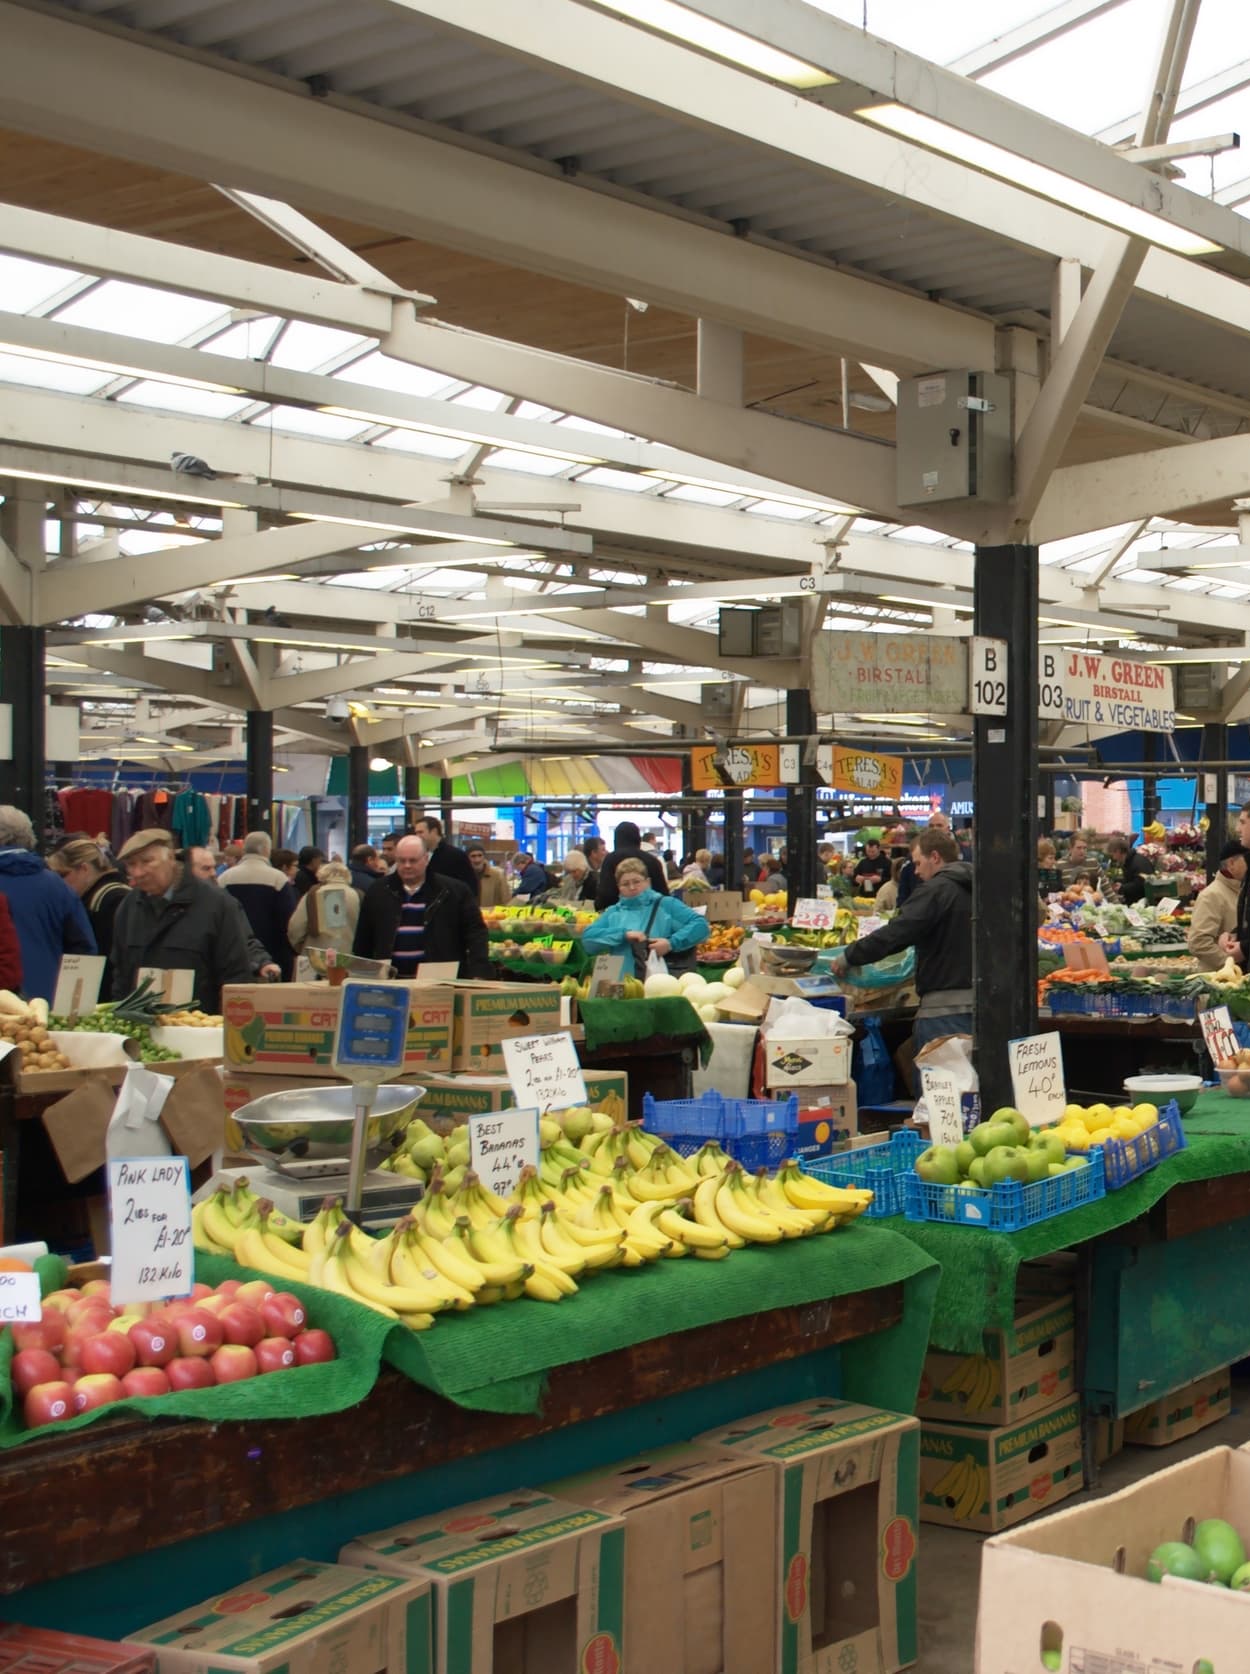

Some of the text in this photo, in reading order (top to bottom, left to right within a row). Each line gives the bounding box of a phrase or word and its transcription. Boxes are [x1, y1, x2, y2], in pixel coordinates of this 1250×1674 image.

[800, 577, 815, 590] C3
[418, 605, 435, 617] C12
[885, 642, 957, 664] GREEN
[985, 648, 997, 672] B
[857, 667, 932, 685] BIRSTALL
[1044, 655, 1055, 678] B
[1068, 653, 1165, 690] J.W. GREEN
[975, 680, 1005, 706] 102
[1093, 684, 1143, 703] BIRSTALL
[1065, 697, 1175, 730] RUIT & VEGETABLES
[716, 769, 757, 784] SLADS
[837, 756, 898, 785] TERESA'S
[519, 993, 558, 1007] BANANAS
[1016, 1040, 1047, 1060] FRESH
[1018, 1056, 1057, 1075] LEMONS
[476, 1122, 504, 1138] BEST
[480, 1137, 526, 1156] BANANAS
[151, 1166, 183, 1186] LADY
[0, 1304, 27, 1319] CH
[1000, 1410, 1077, 1456] PREMIUM BANANAS
[922, 1439, 953, 1455] ANAS
[438, 1536, 524, 1570] BANANAS
